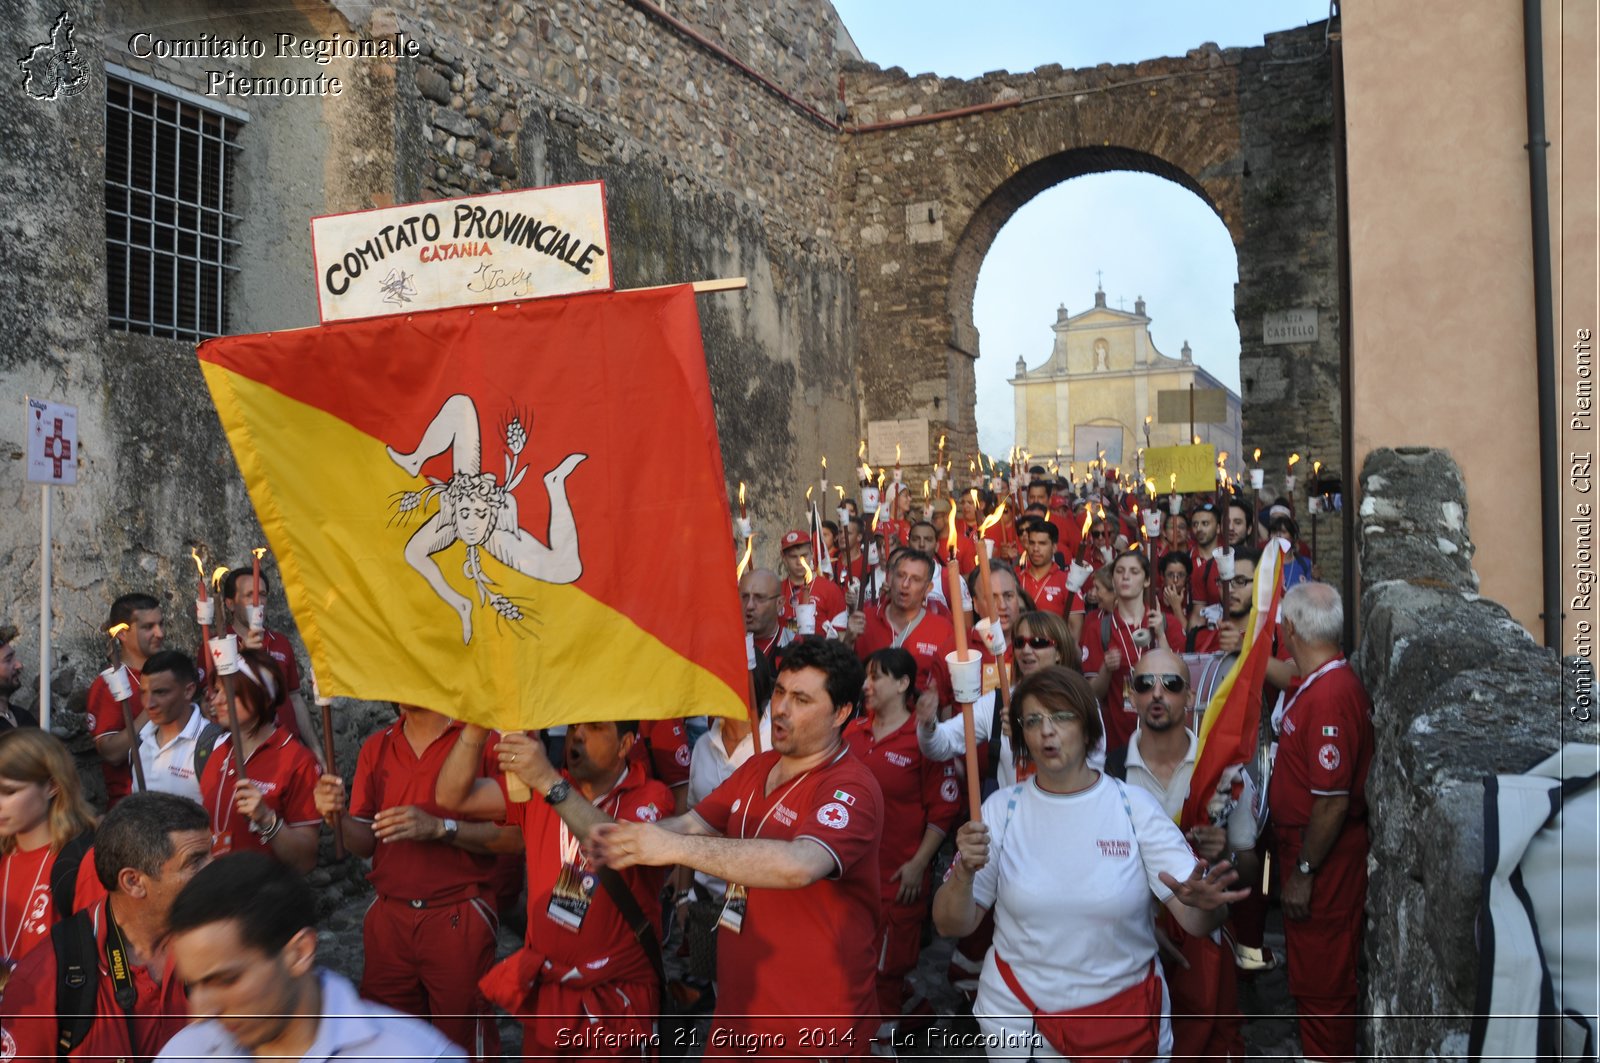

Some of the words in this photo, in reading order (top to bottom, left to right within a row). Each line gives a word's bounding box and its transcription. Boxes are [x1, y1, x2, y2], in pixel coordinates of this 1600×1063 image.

[326, 213, 440, 295] COMITATO
[453, 204, 604, 275] PROVINCIALE
[419, 241, 493, 263] CATANIA
[1267, 325, 1314, 338] CASTELLO
[112, 949, 126, 979] Nikon
